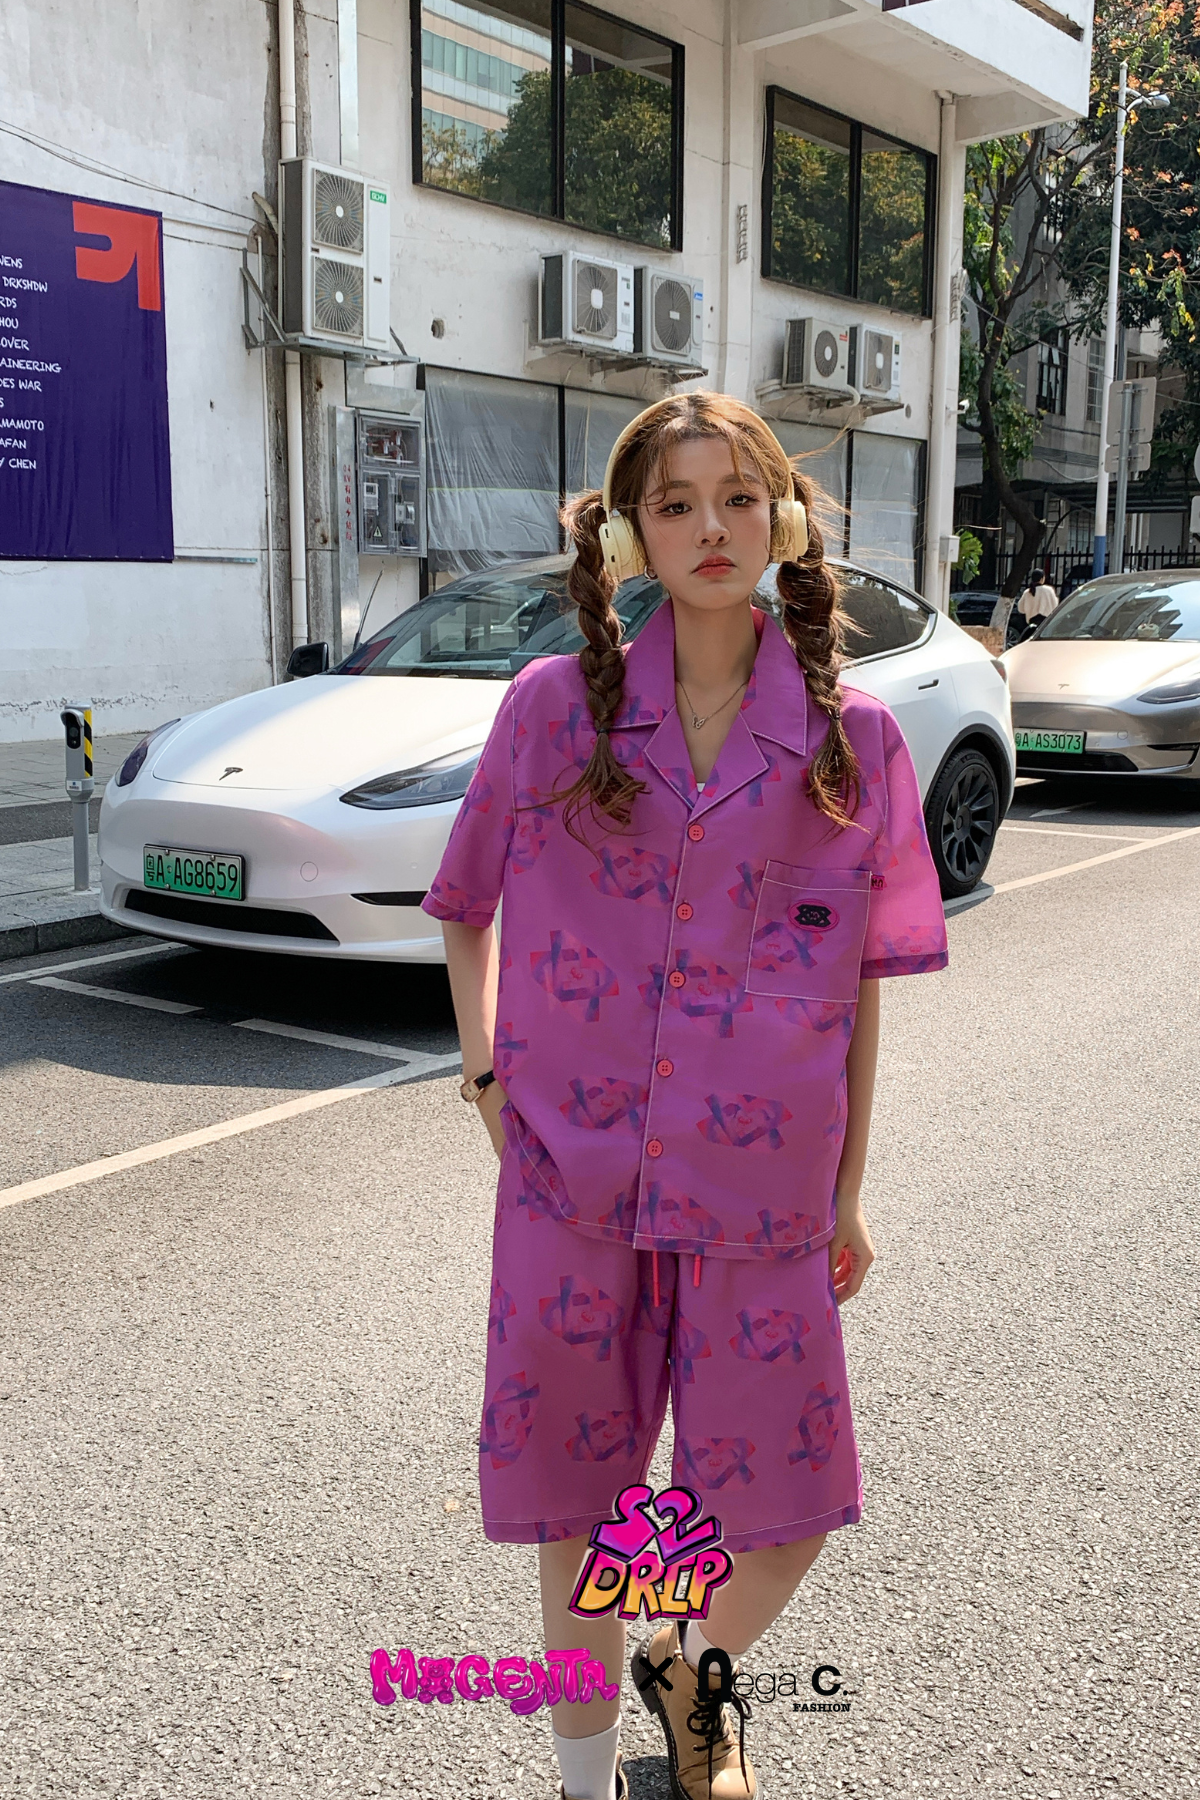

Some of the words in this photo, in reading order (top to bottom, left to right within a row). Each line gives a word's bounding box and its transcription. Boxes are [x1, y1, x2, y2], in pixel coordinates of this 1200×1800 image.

[2, 276, 48, 292] DRKSHDW
[0, 357, 62, 373] AINEERING
[18, 379, 42, 392] WAR
[8, 458, 37, 469] CHEN
